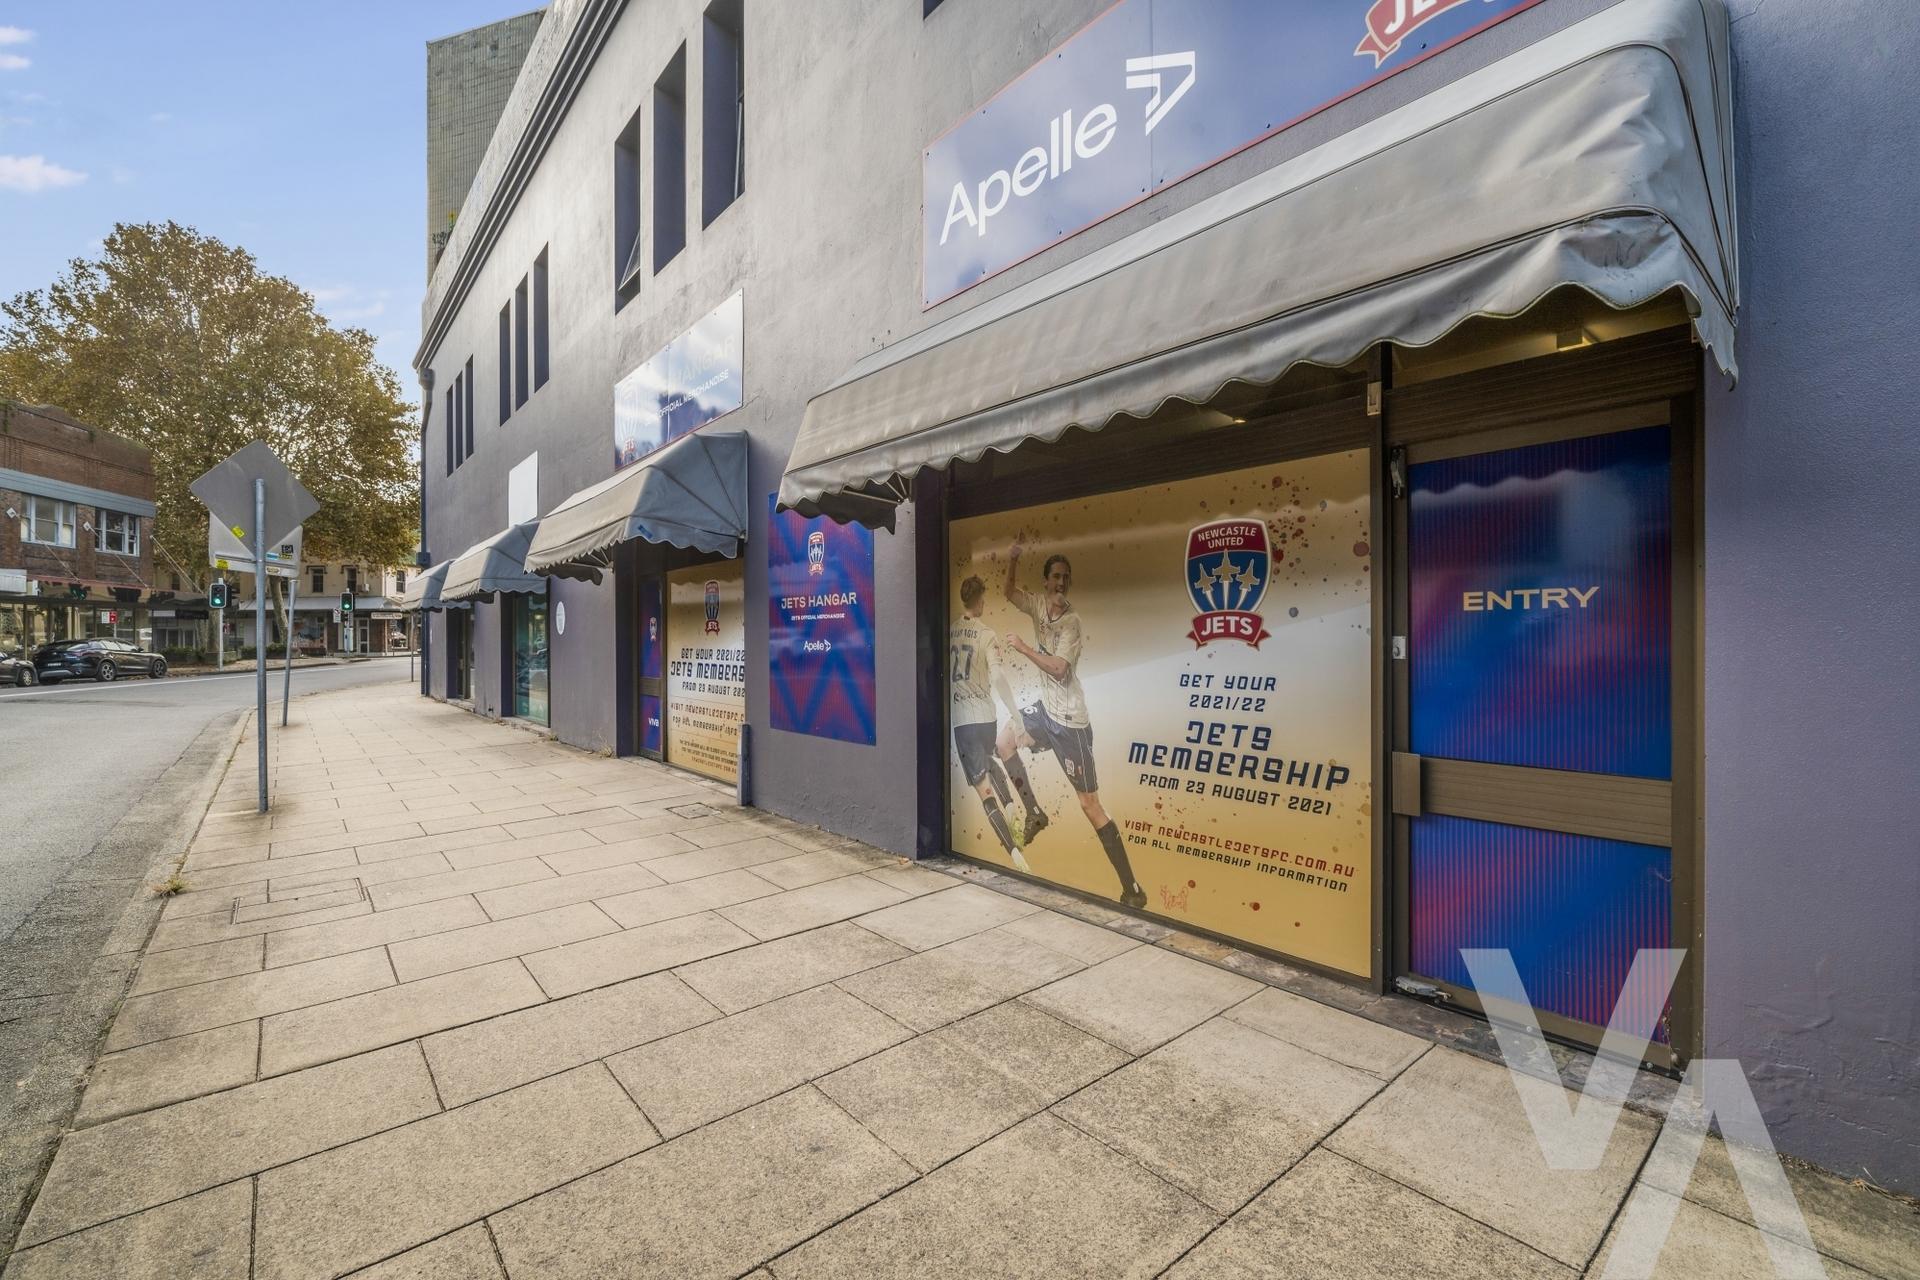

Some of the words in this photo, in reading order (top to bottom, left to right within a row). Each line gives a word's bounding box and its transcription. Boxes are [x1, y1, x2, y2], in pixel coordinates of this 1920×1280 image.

[939, 103, 1117, 246] Apelle
[683, 368, 729, 404] MERCHANDISE
[1198, 526, 1257, 542] NEWCASTLE
[1207, 537, 1244, 549] UNITED
[781, 597, 806, 610] JETS
[808, 592, 857, 608] HANGAR
[1463, 586, 1599, 611] ENTRY
[1201, 616, 1253, 636] JETS
[681, 648, 693, 659] GET
[695, 648, 713, 660] YOUR
[716, 649, 744, 661] 2021/22
[803, 640, 824, 652] Apelle
[671, 661, 693, 677] JETS
[951, 645, 974, 682] 27
[682, 681, 696, 692] FROM
[698, 683, 705, 693] 23
[707, 684, 731, 696] AUGUST
[1179, 674, 1215, 688] GET
[1224, 676, 1276, 691] YOUR
[1189, 694, 1266, 712] 2021/22
[1186, 720, 1272, 751] JETS
[1128, 742, 1350, 791] MEMBERSHIP
[1139, 773, 1179, 790] FROM
[1185, 780, 1205, 794] 23
[1212, 784, 1280, 806] AUGUST
[1288, 796, 1331, 816] 2021
[1124, 819, 1153, 833] VISIT
[1158, 826, 1355, 878] NEWCASTLEJETSFC.COM.AU
[1128, 834, 1147, 846] FOR
[1151, 839, 1171, 850] ALL
[1176, 844, 1251, 868] MEMBERSHIP
[1256, 862, 1348, 893] INFORMATION
